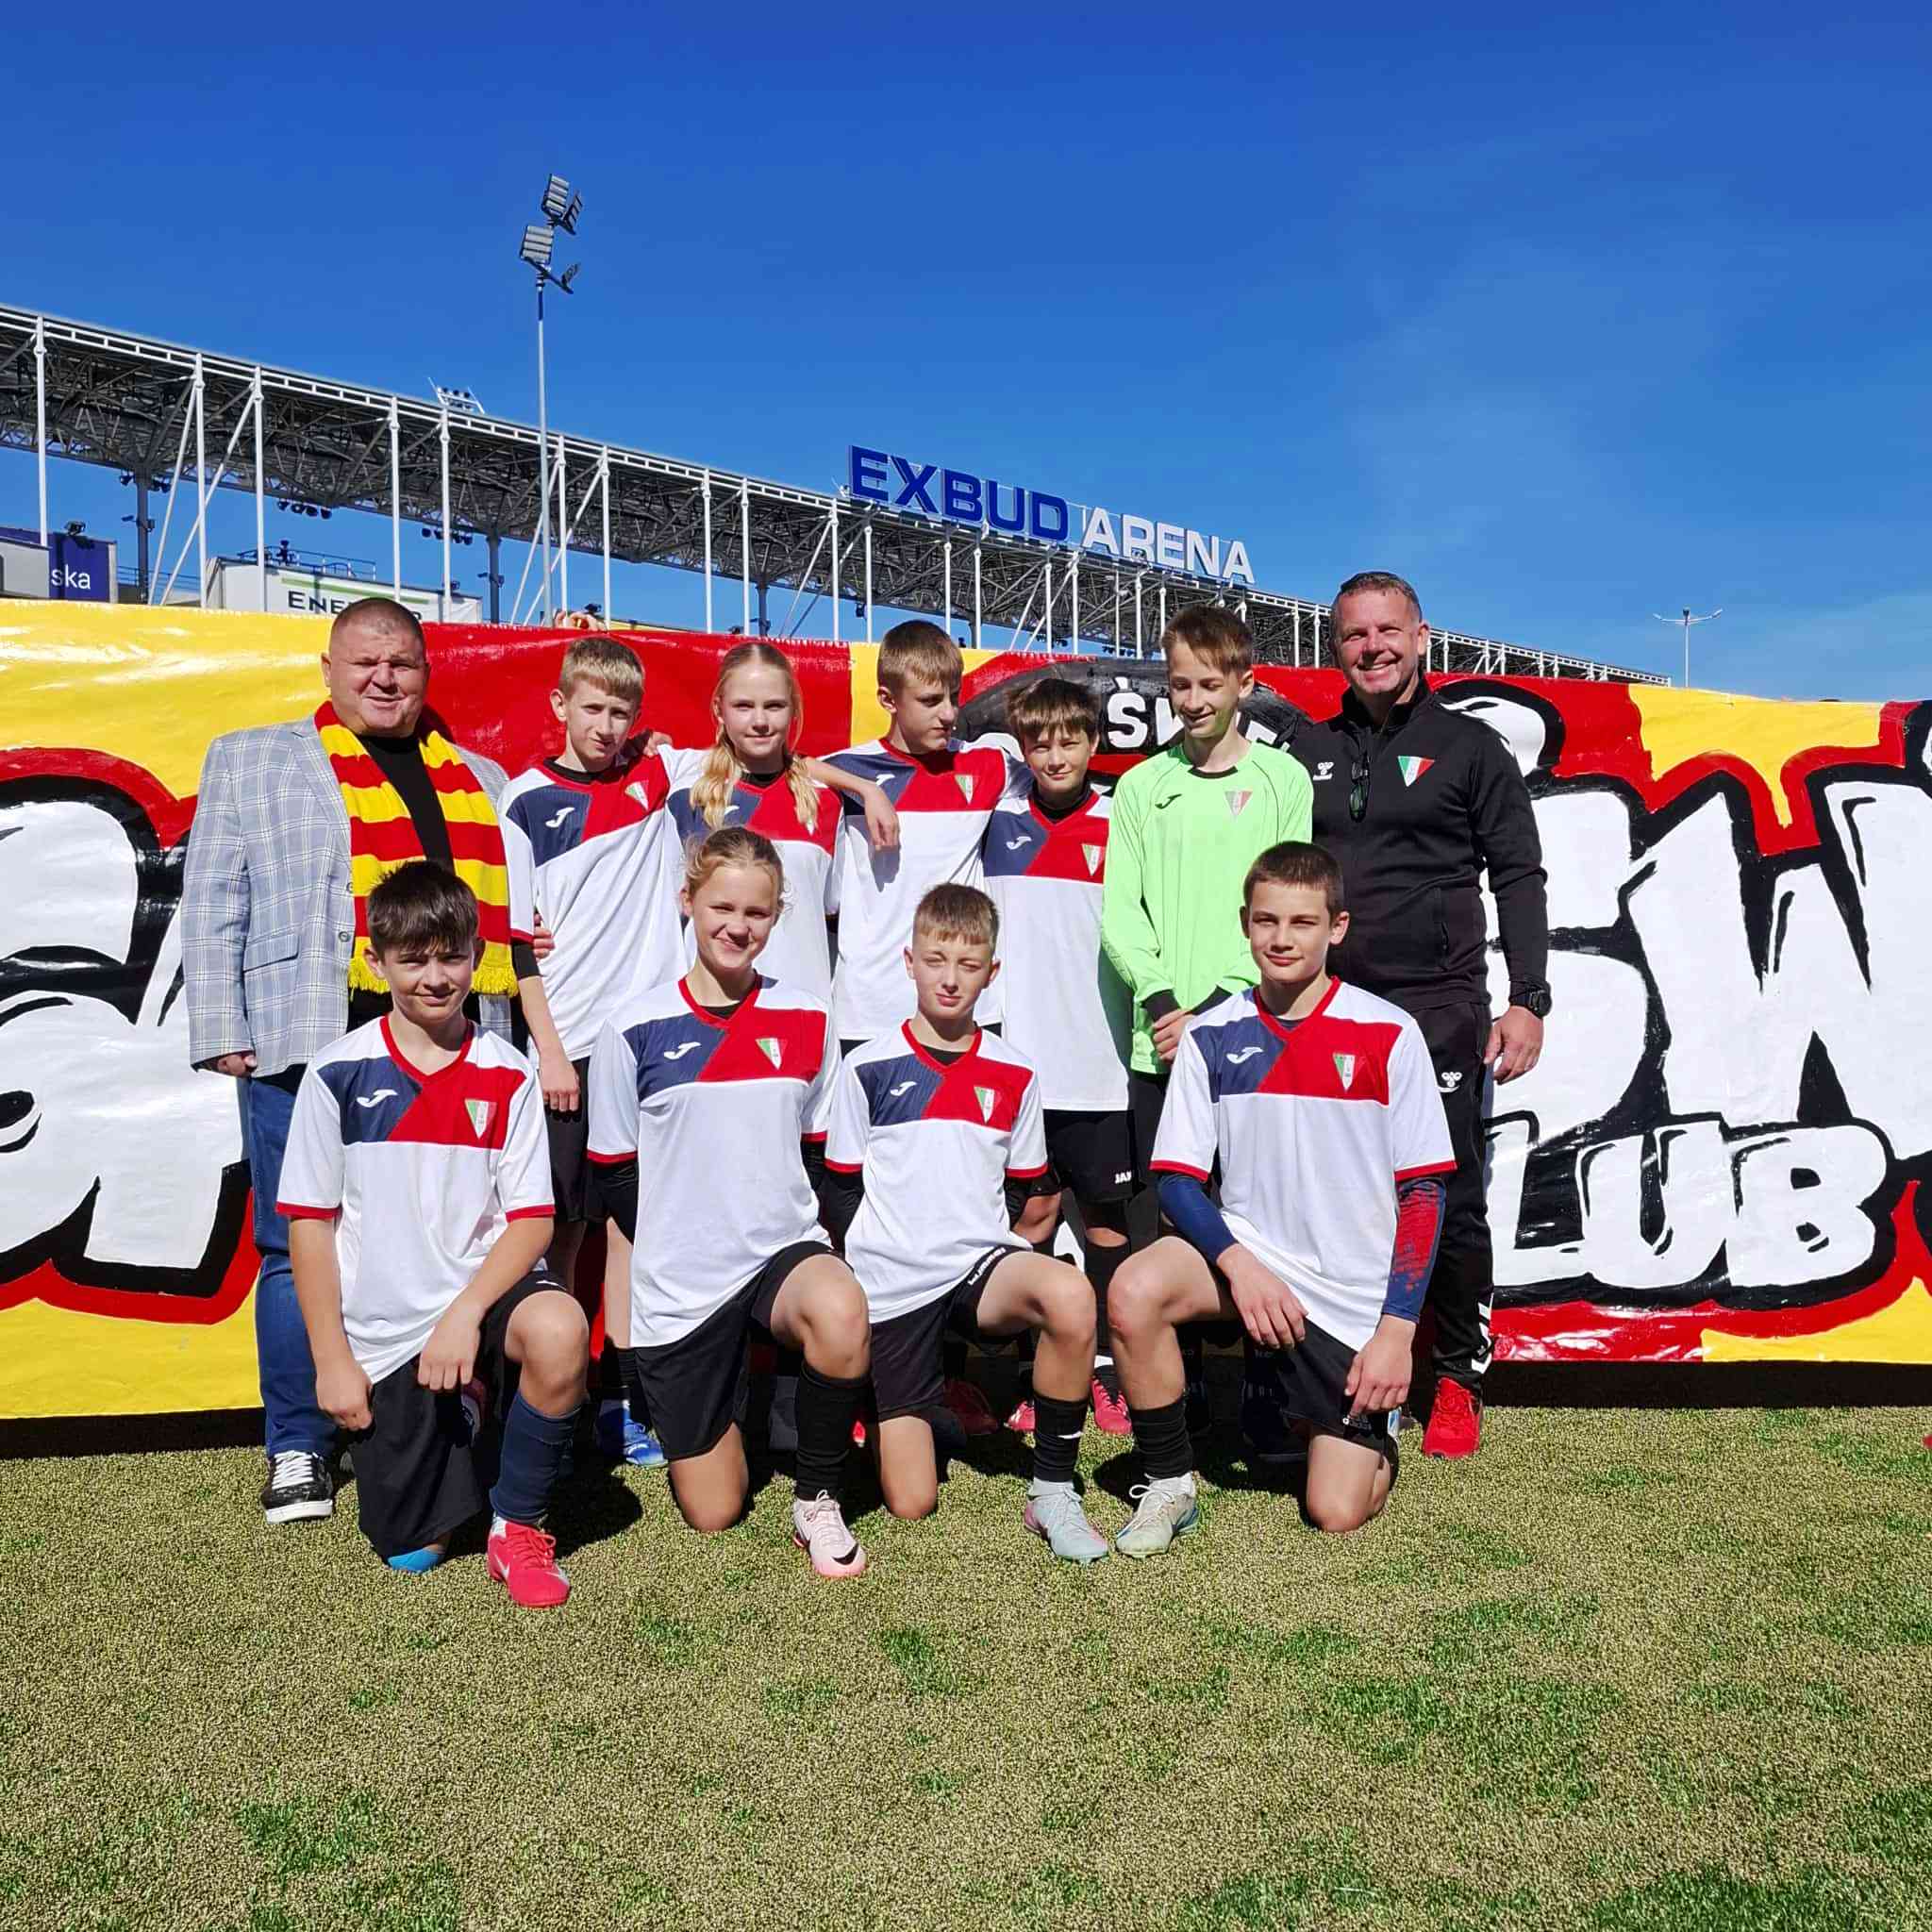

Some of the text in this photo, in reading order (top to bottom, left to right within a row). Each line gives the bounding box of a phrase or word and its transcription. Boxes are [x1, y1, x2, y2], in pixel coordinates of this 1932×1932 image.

[51, 563, 92, 590] ska
[850, 445, 1256, 584] EXBUD ARENA
[1487, 1119, 1887, 1289] LUB
